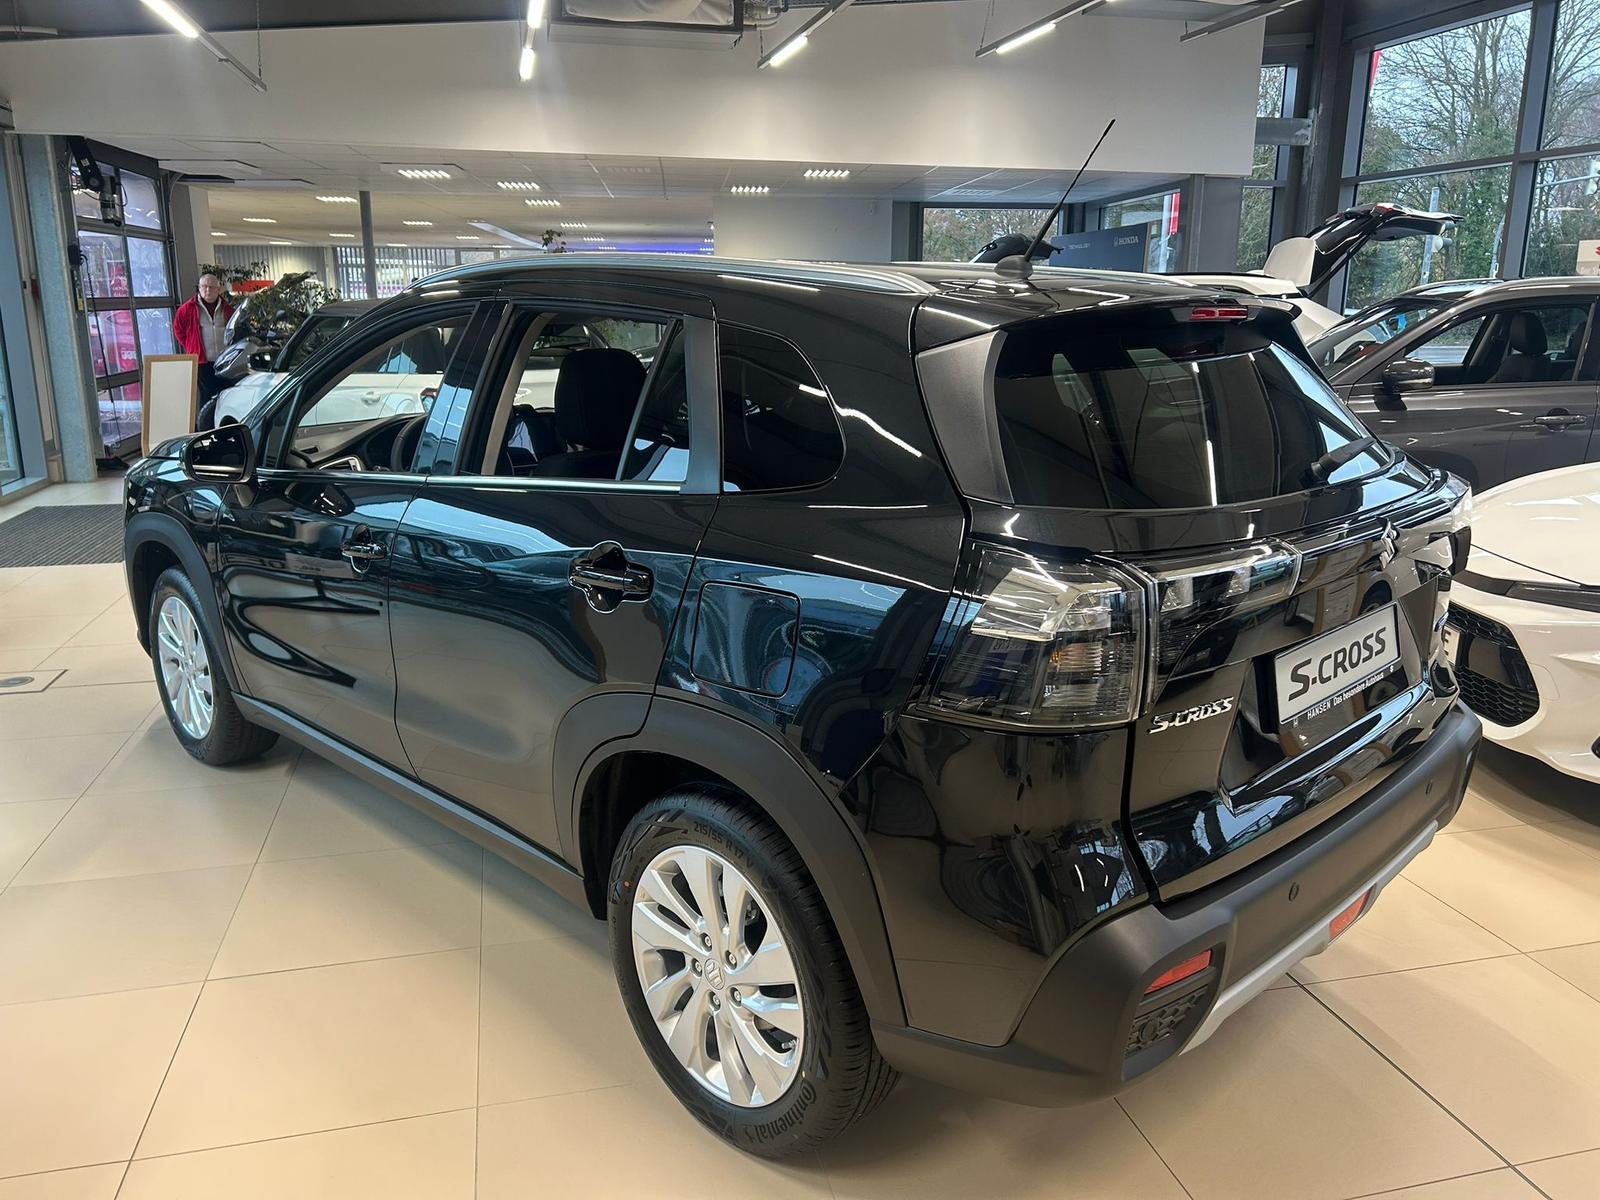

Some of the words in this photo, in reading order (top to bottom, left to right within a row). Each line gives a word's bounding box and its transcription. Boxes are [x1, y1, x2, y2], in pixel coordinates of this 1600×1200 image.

[1307, 702, 1331, 720] HANSEN
[1333, 695, 1343, 706] Das
[755, 1080, 816, 1143] Continental
